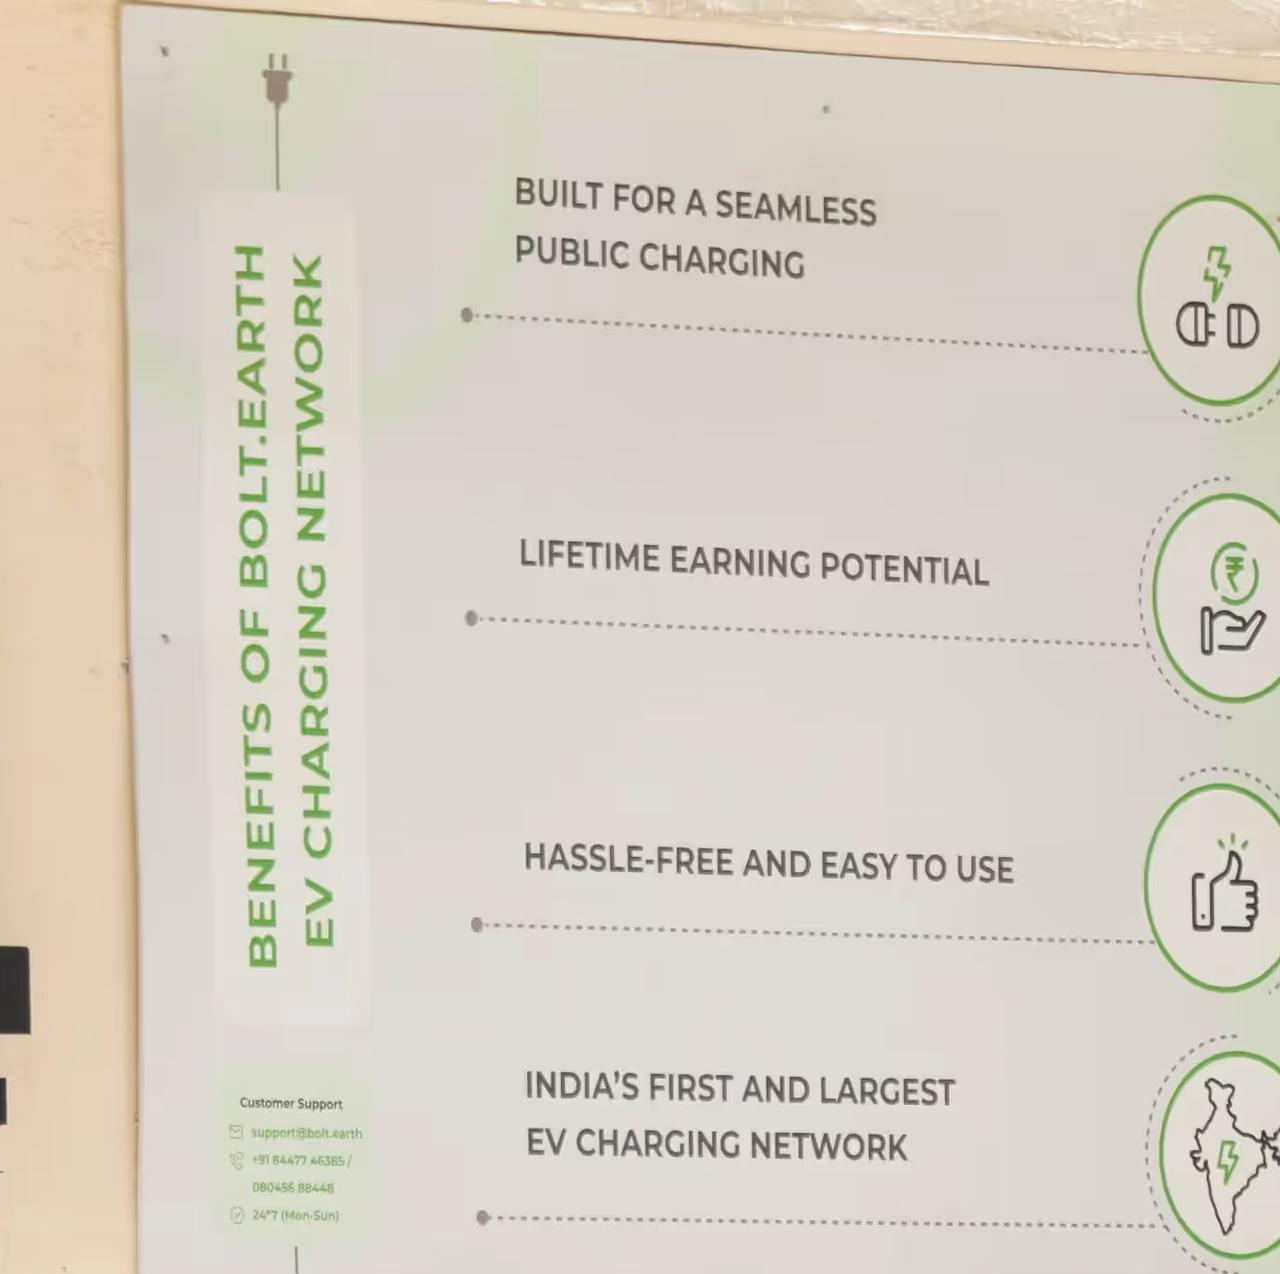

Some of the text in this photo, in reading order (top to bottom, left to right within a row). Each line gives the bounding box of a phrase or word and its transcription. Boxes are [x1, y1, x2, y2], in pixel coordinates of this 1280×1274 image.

[516, 177, 876, 227] BUILT FOR A SEAMLESS
[517, 235, 804, 279] PUBLIC CHARGING
[521, 539, 989, 586] LIFETIME EARNING POTENTIAL
[235, 245, 277, 968] BENEFITS OF BOLT.EARTH
[292, 252, 334, 948] EV CHARGING NETWORK
[526, 843, 1014, 883] HASSLE-FREE AND EASY TO USE
[240, 1097, 343, 1112] Customer Support
[650, 1074, 733, 1101] FIRST
[742, 1075, 809, 1103] AND
[821, 1077, 956, 1105] LARGEST
[528, 1128, 907, 1161] EV CHARGING NETWORK
